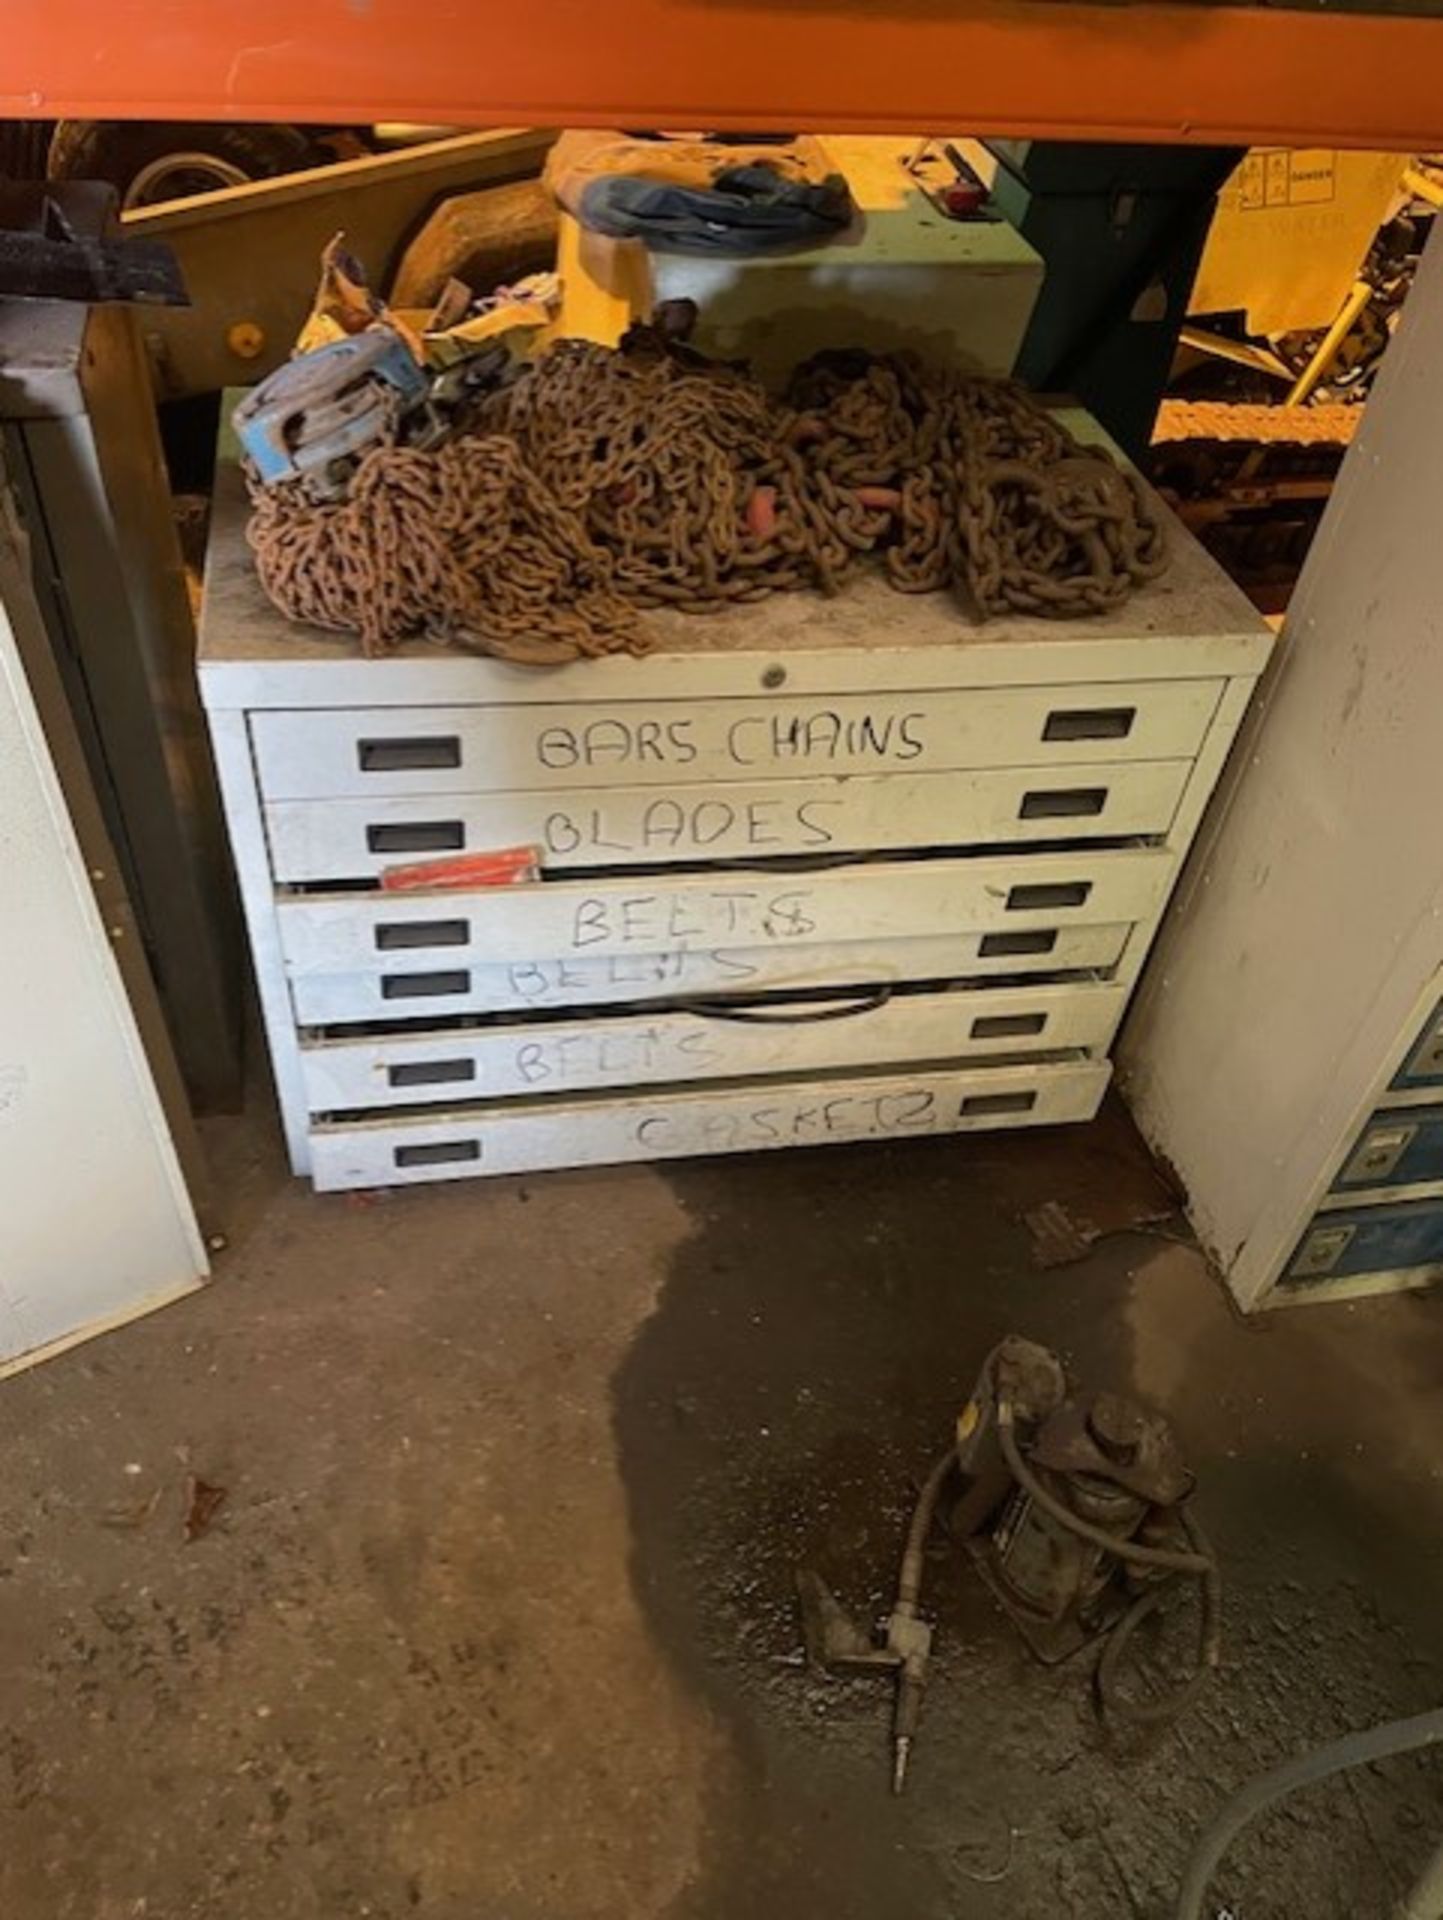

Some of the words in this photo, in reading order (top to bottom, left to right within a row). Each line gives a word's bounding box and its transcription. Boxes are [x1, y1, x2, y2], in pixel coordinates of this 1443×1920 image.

[537, 719, 697, 768] BARS
[728, 711, 926, 764] CHAINS
[545, 799, 844, 854] BLADES
